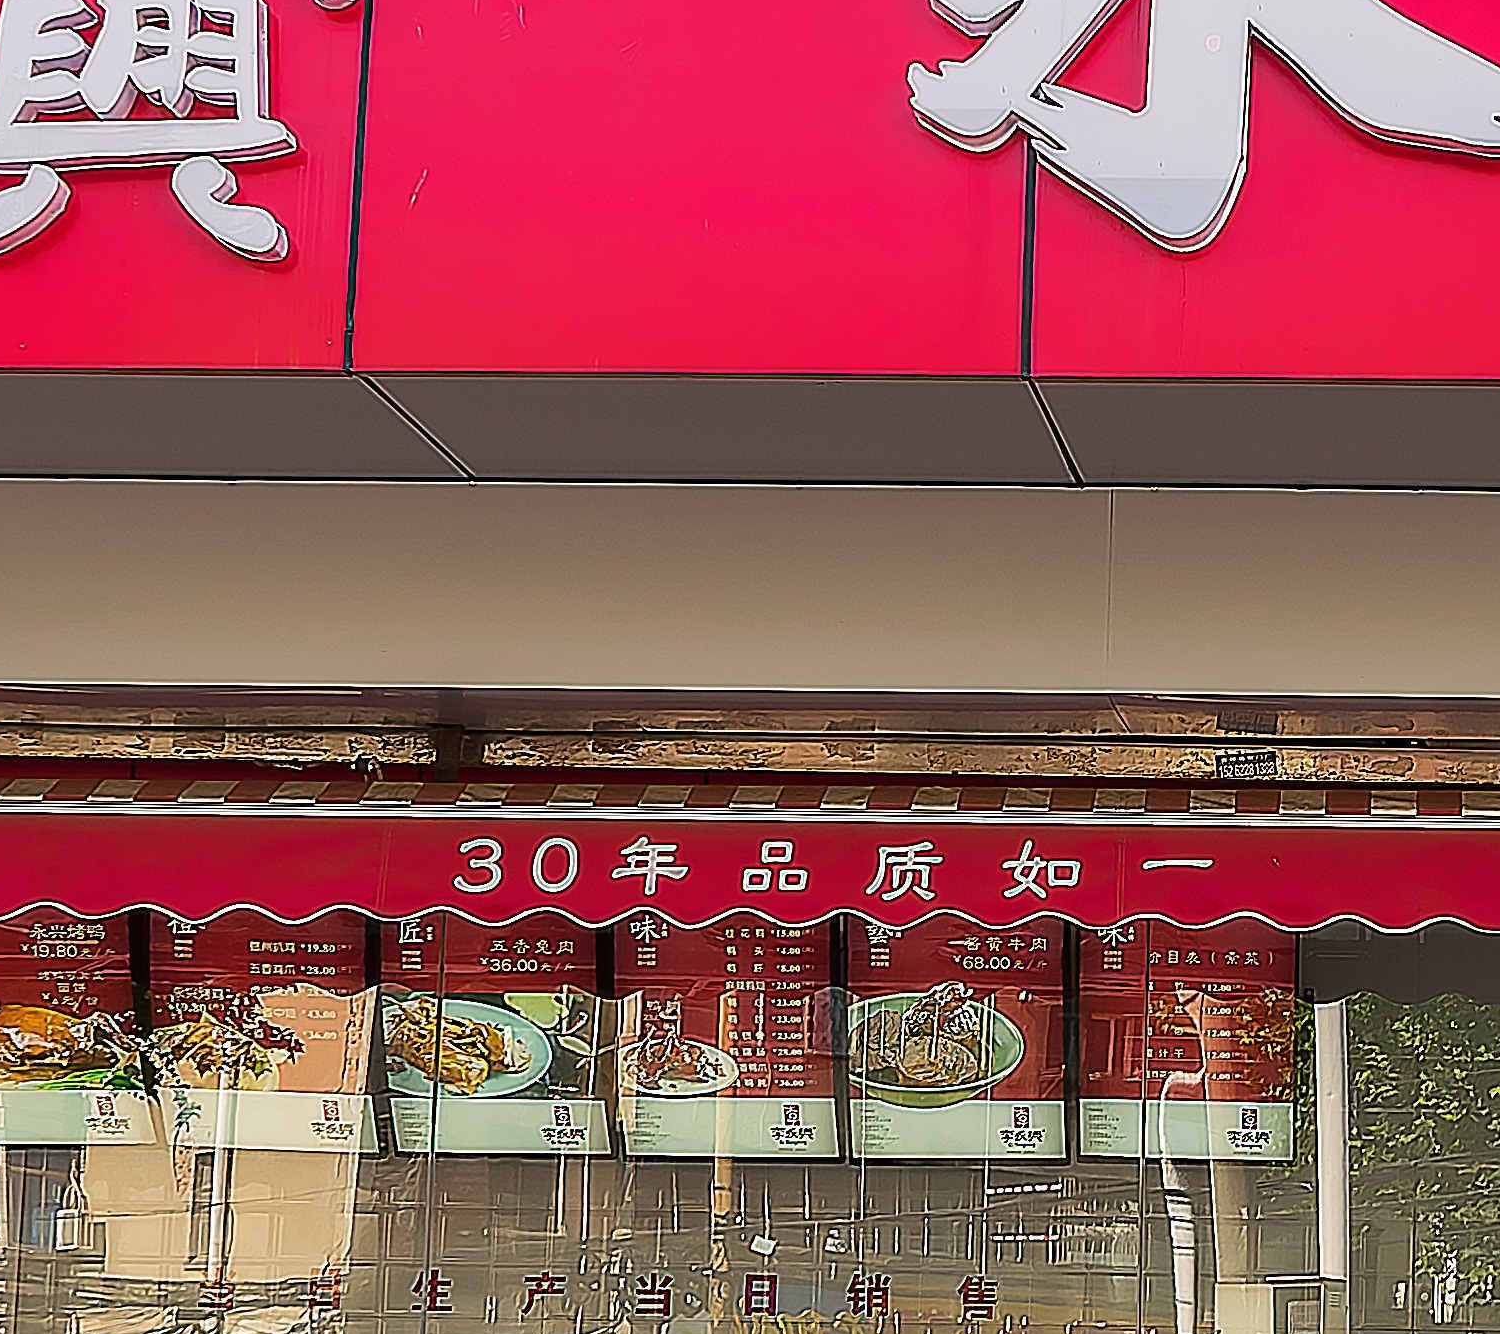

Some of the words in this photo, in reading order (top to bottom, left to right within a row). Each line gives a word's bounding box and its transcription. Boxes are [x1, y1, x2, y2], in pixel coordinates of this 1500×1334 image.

[453, 835, 1215, 902] 30年品质如一
